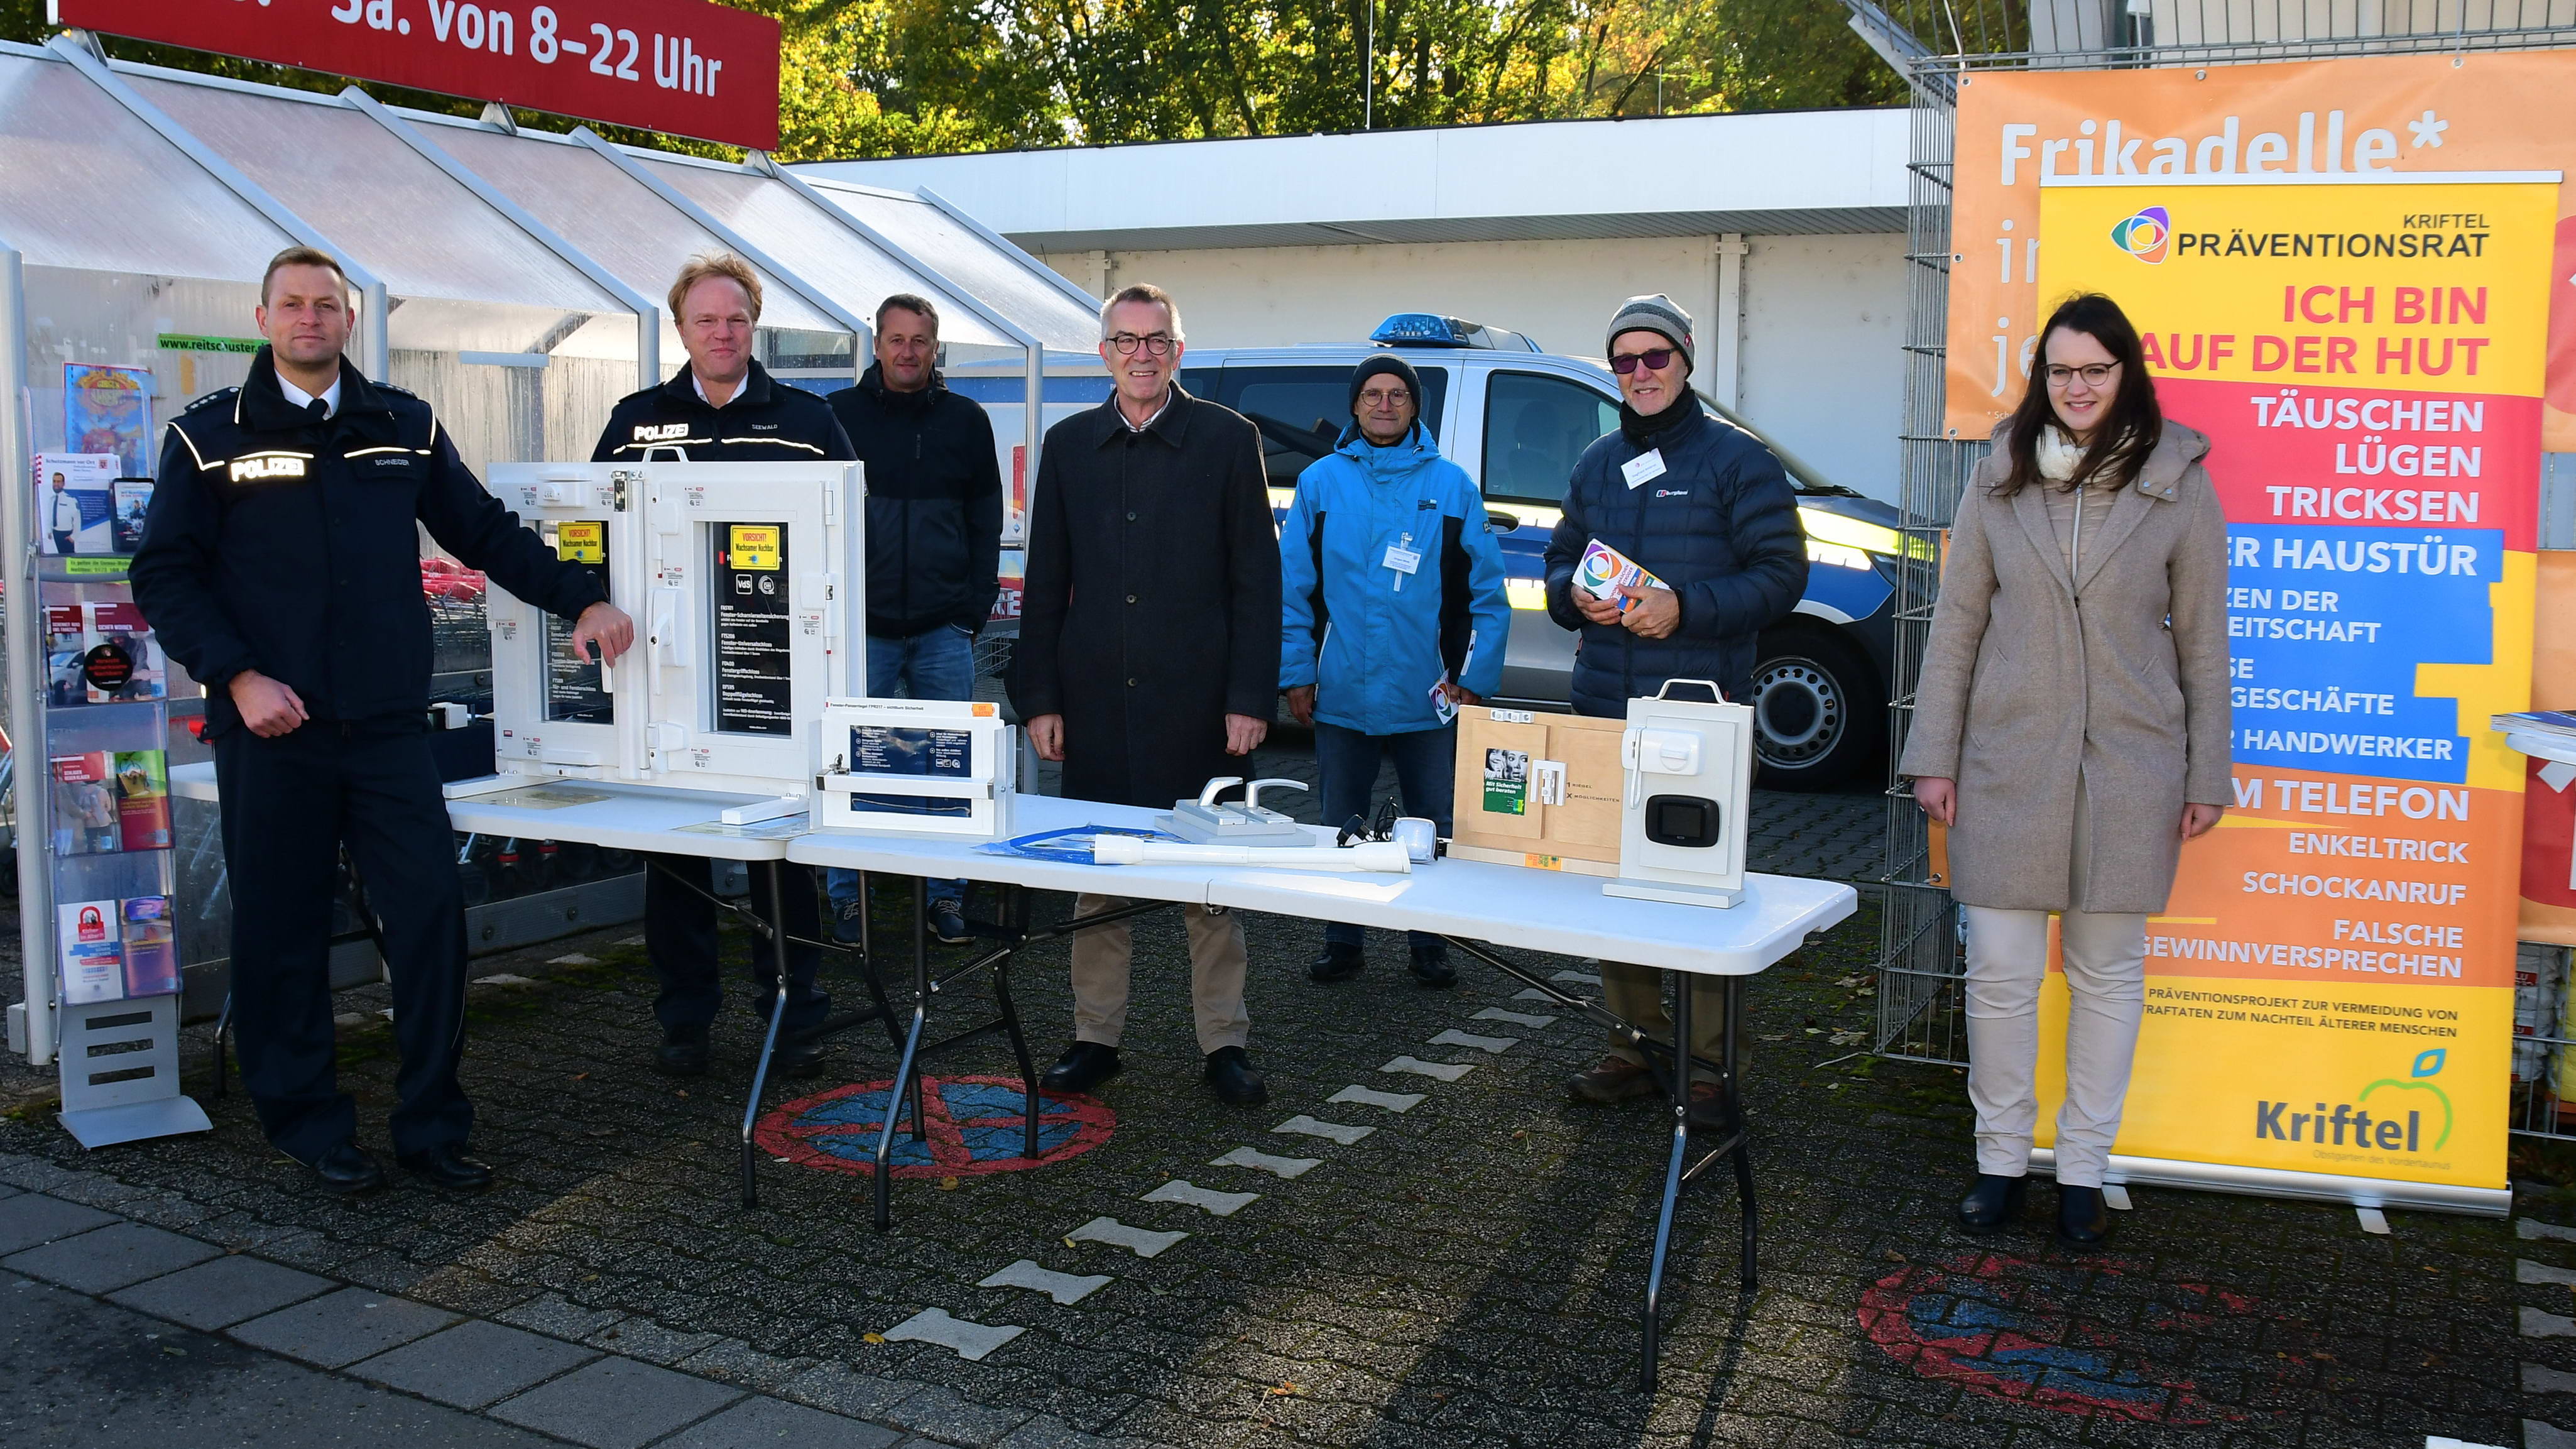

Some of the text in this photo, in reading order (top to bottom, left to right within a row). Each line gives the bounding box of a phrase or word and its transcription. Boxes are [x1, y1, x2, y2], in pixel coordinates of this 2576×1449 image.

[428, 0, 513, 54] von
[654, 33, 723, 97] Uhr
[2403, 214, 2490, 229] KRIFTEL
[2179, 229, 2490, 258] PRÄVENTIONSRAT
[2284, 285, 2487, 324] ICH BIN
[2141, 332, 2491, 375] AUF DER HUT
[2251, 388, 2485, 432] TÄUSCHEN
[634, 423, 689, 440] POLIZEI
[230, 457, 304, 482] POLIZEI
[2335, 435, 2482, 478] LÜGEN
[2266, 485, 2479, 522] TRICKSEN
[736, 543, 757, 551] Wachsamer
[743, 533, 767, 542] VORSICHT!
[2273, 535, 2478, 576] HAUSTÜR
[738, 580, 751, 588] VdS
[2227, 588, 2339, 613] EN DER
[2244, 729, 2453, 760] HANDWERKER
[1496, 782, 1522, 790] Sicherheit
[2274, 779, 2469, 821] TELEFON
[2289, 833, 2469, 863] ENKELTRICK
[2242, 870, 2467, 905] SCHOCKANRUF
[2334, 919, 2464, 948] FALSCHE
[2149, 988, 2458, 1020] PRÄVENTIONSPROJEKT ZUR VERMEIDUNG VON
[2217, 1010, 2246, 1021] ZUM
[2251, 1012, 2315, 1027] NACHTEIL
[2319, 1015, 2376, 1031] ÄLTERER
[2380, 1022, 2457, 1037] MENSCHEN
[2256, 1100, 2420, 1152] Kriftel
[2313, 1149, 2451, 1170] Obstgarten des Vordertaunus
